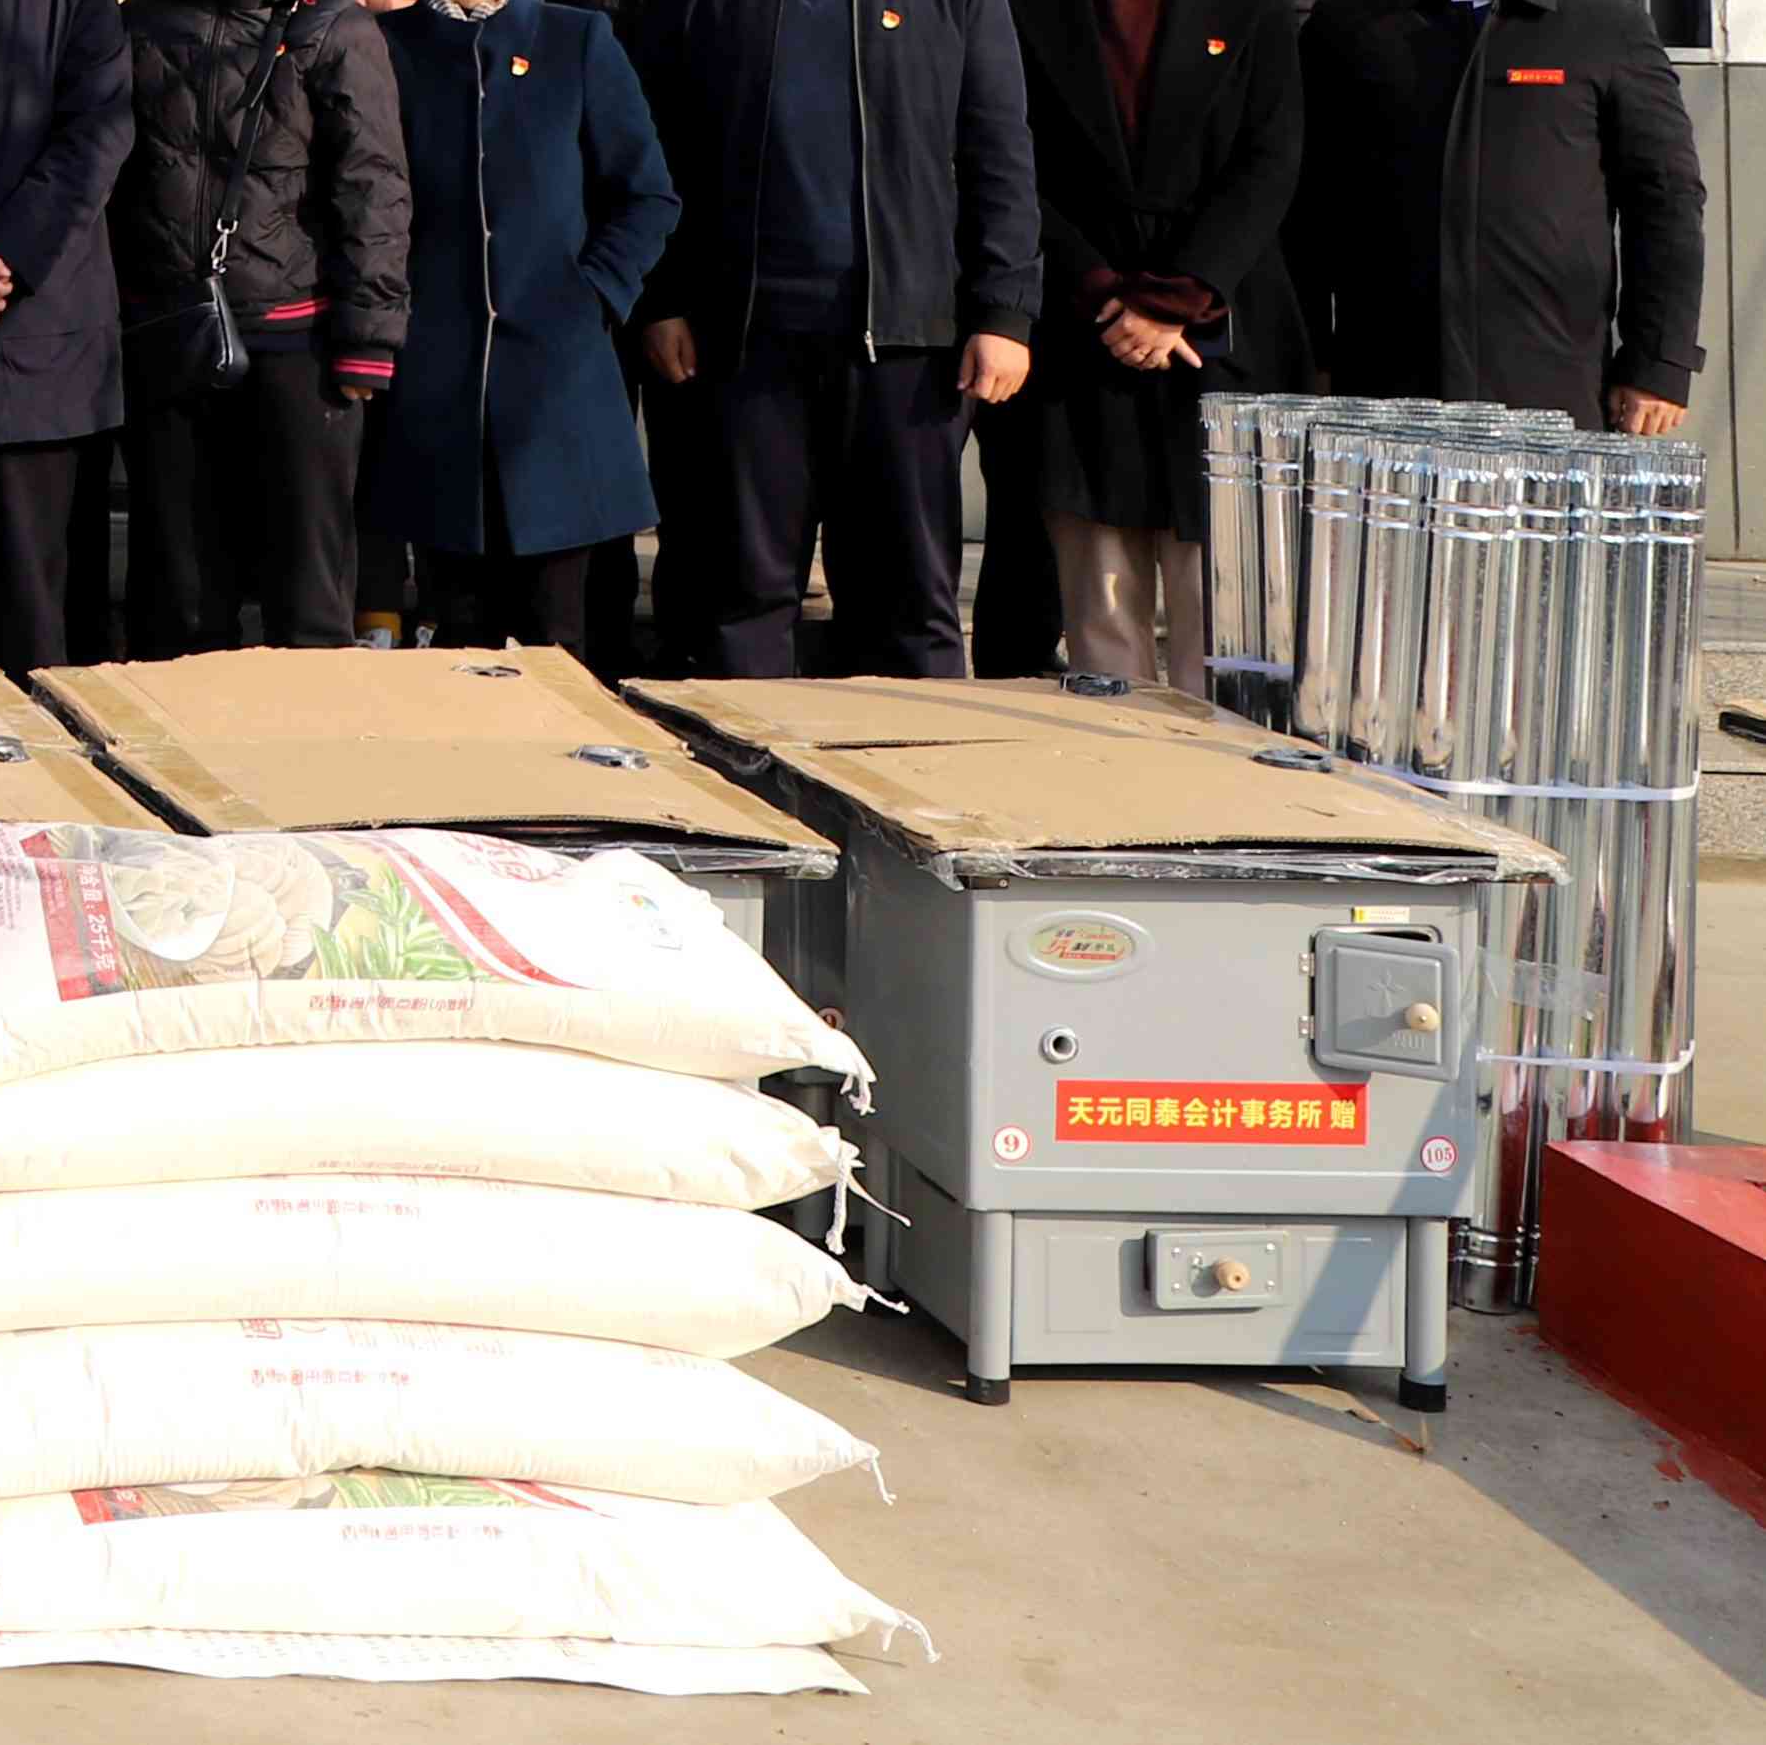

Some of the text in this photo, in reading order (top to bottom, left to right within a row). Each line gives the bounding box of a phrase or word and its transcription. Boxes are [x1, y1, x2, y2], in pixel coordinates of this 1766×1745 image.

[1067, 1096, 1356, 1130] 天元同泰会计事务所 赠
[1003, 1136, 1020, 1154] 9
[1426, 1146, 1453, 1164] 105
